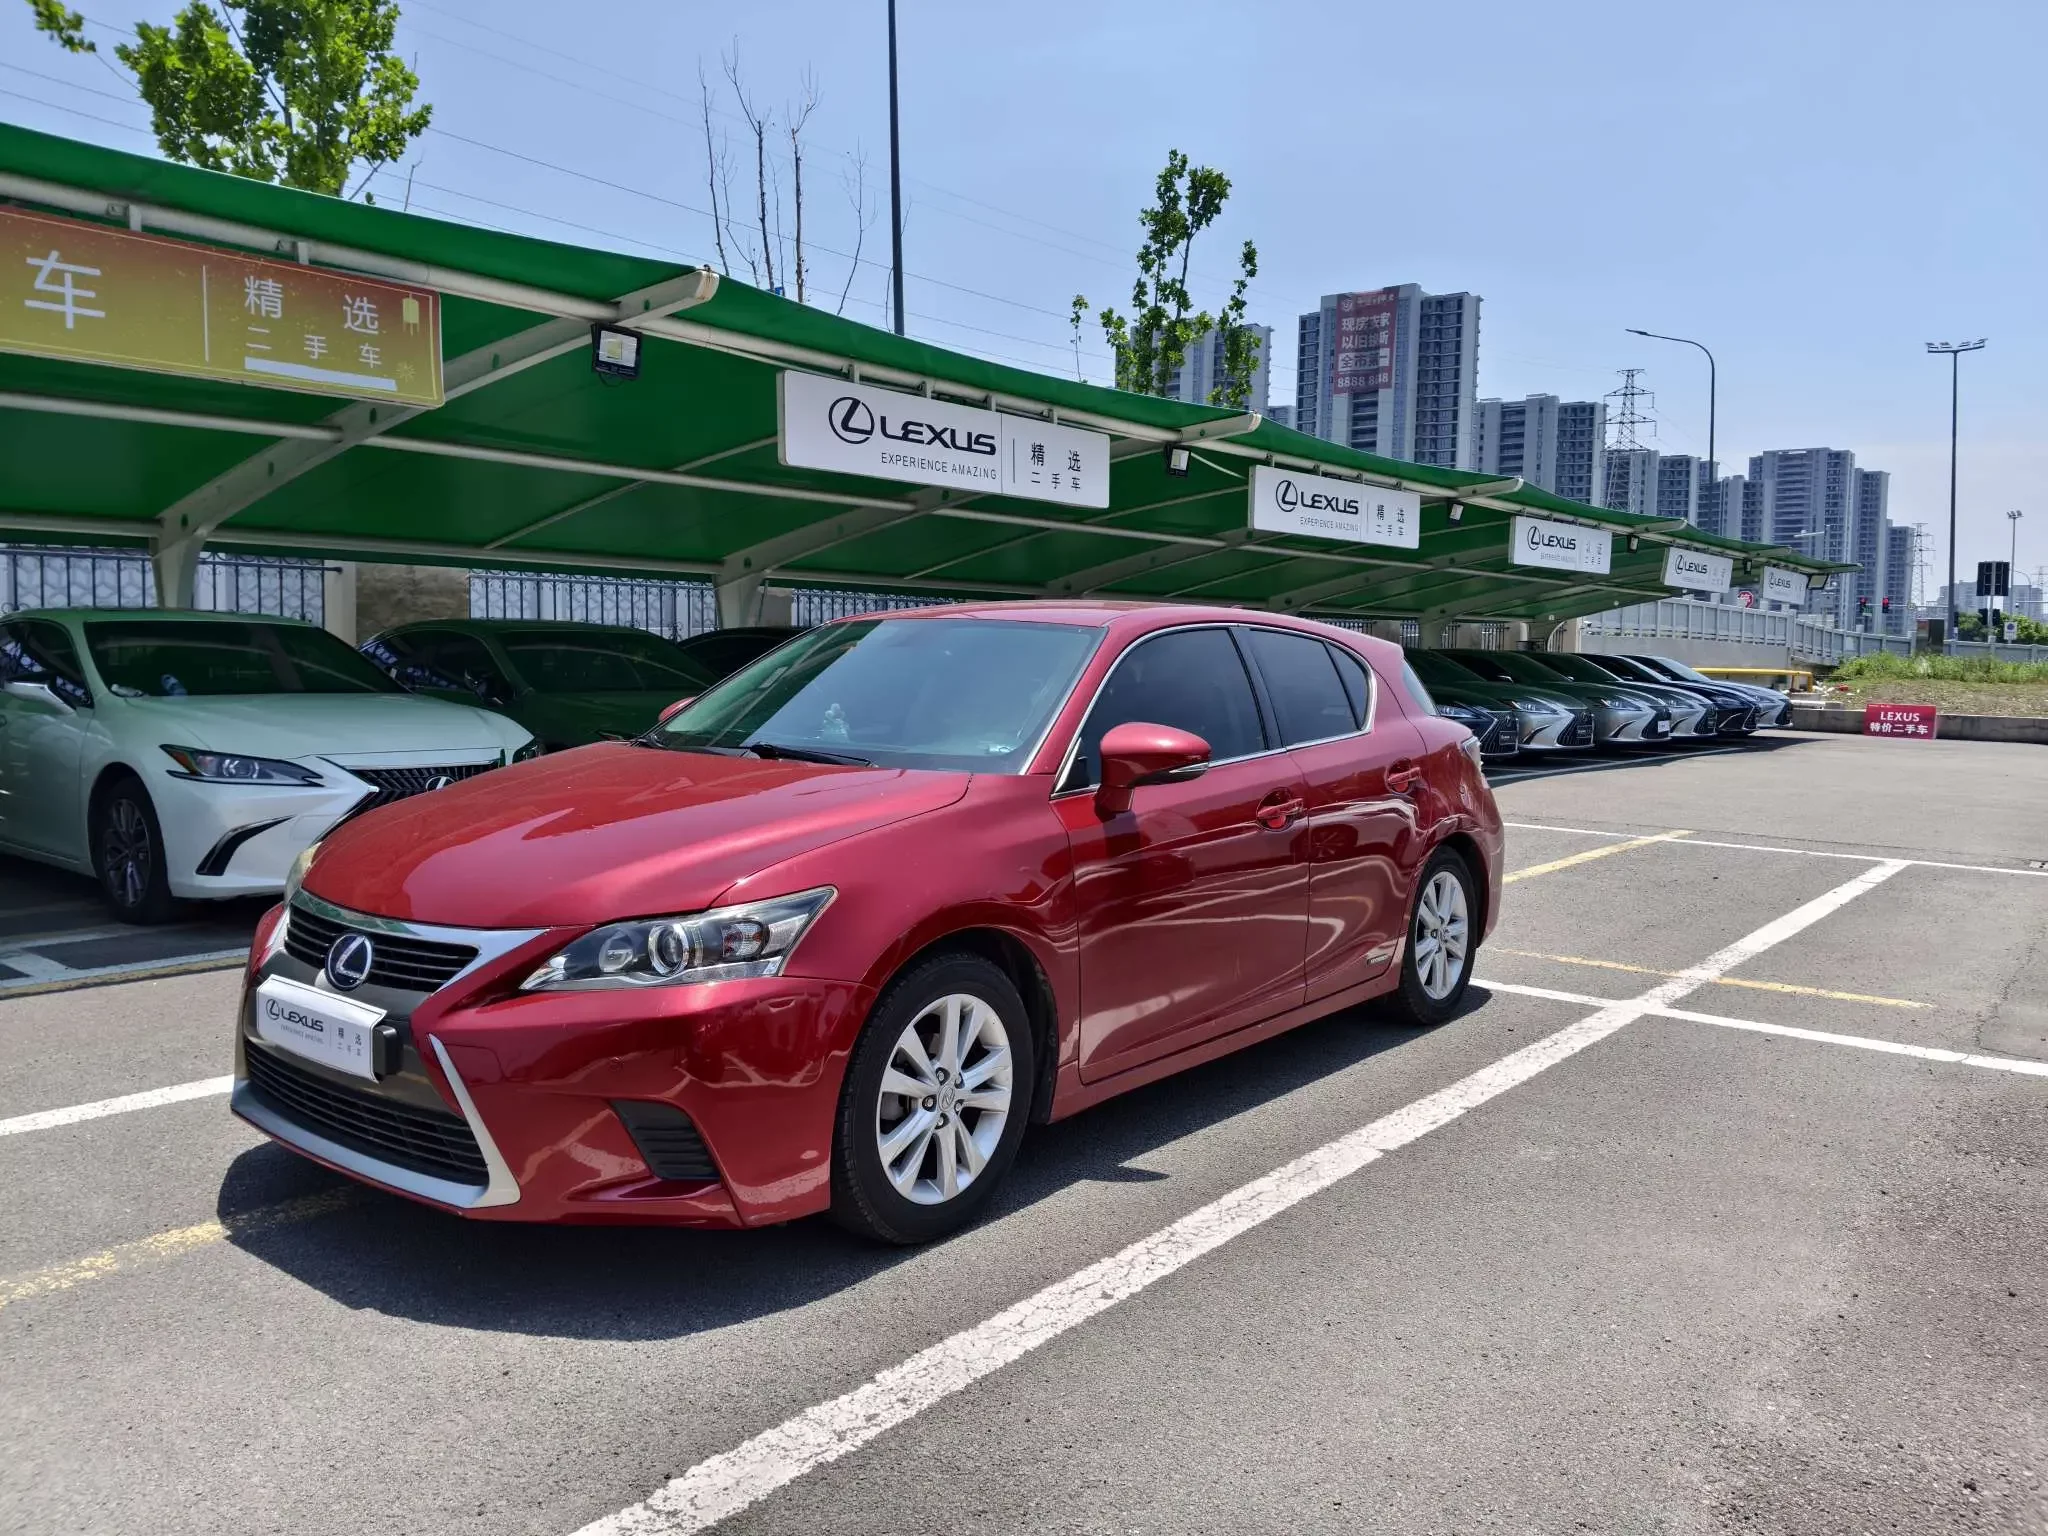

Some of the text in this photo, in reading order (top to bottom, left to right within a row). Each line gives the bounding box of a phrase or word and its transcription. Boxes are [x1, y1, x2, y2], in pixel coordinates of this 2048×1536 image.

[24, 249, 106, 329] 车
[244, 276, 379, 335] 精选
[247, 325, 381, 368] 二手车
[880, 415, 997, 456] LEXUS
[881, 452, 997, 480] EXPERIENCE AMAZING
[1030, 442, 1081, 473] 精选
[1031, 471, 1081, 491] 二手车
[1301, 491, 1359, 515] LEXUS
[1300, 516, 1334, 529] EXPERIENCE
[1541, 534, 1577, 551] LEXUS
[1684, 561, 1708, 574] LEXUS
[1774, 577, 1791, 589] LEXUS
[1869, 722, 1928, 735] 特价二手车
[1880, 711, 1920, 722] LEXUS
[281, 1009, 324, 1033] LEXUS
